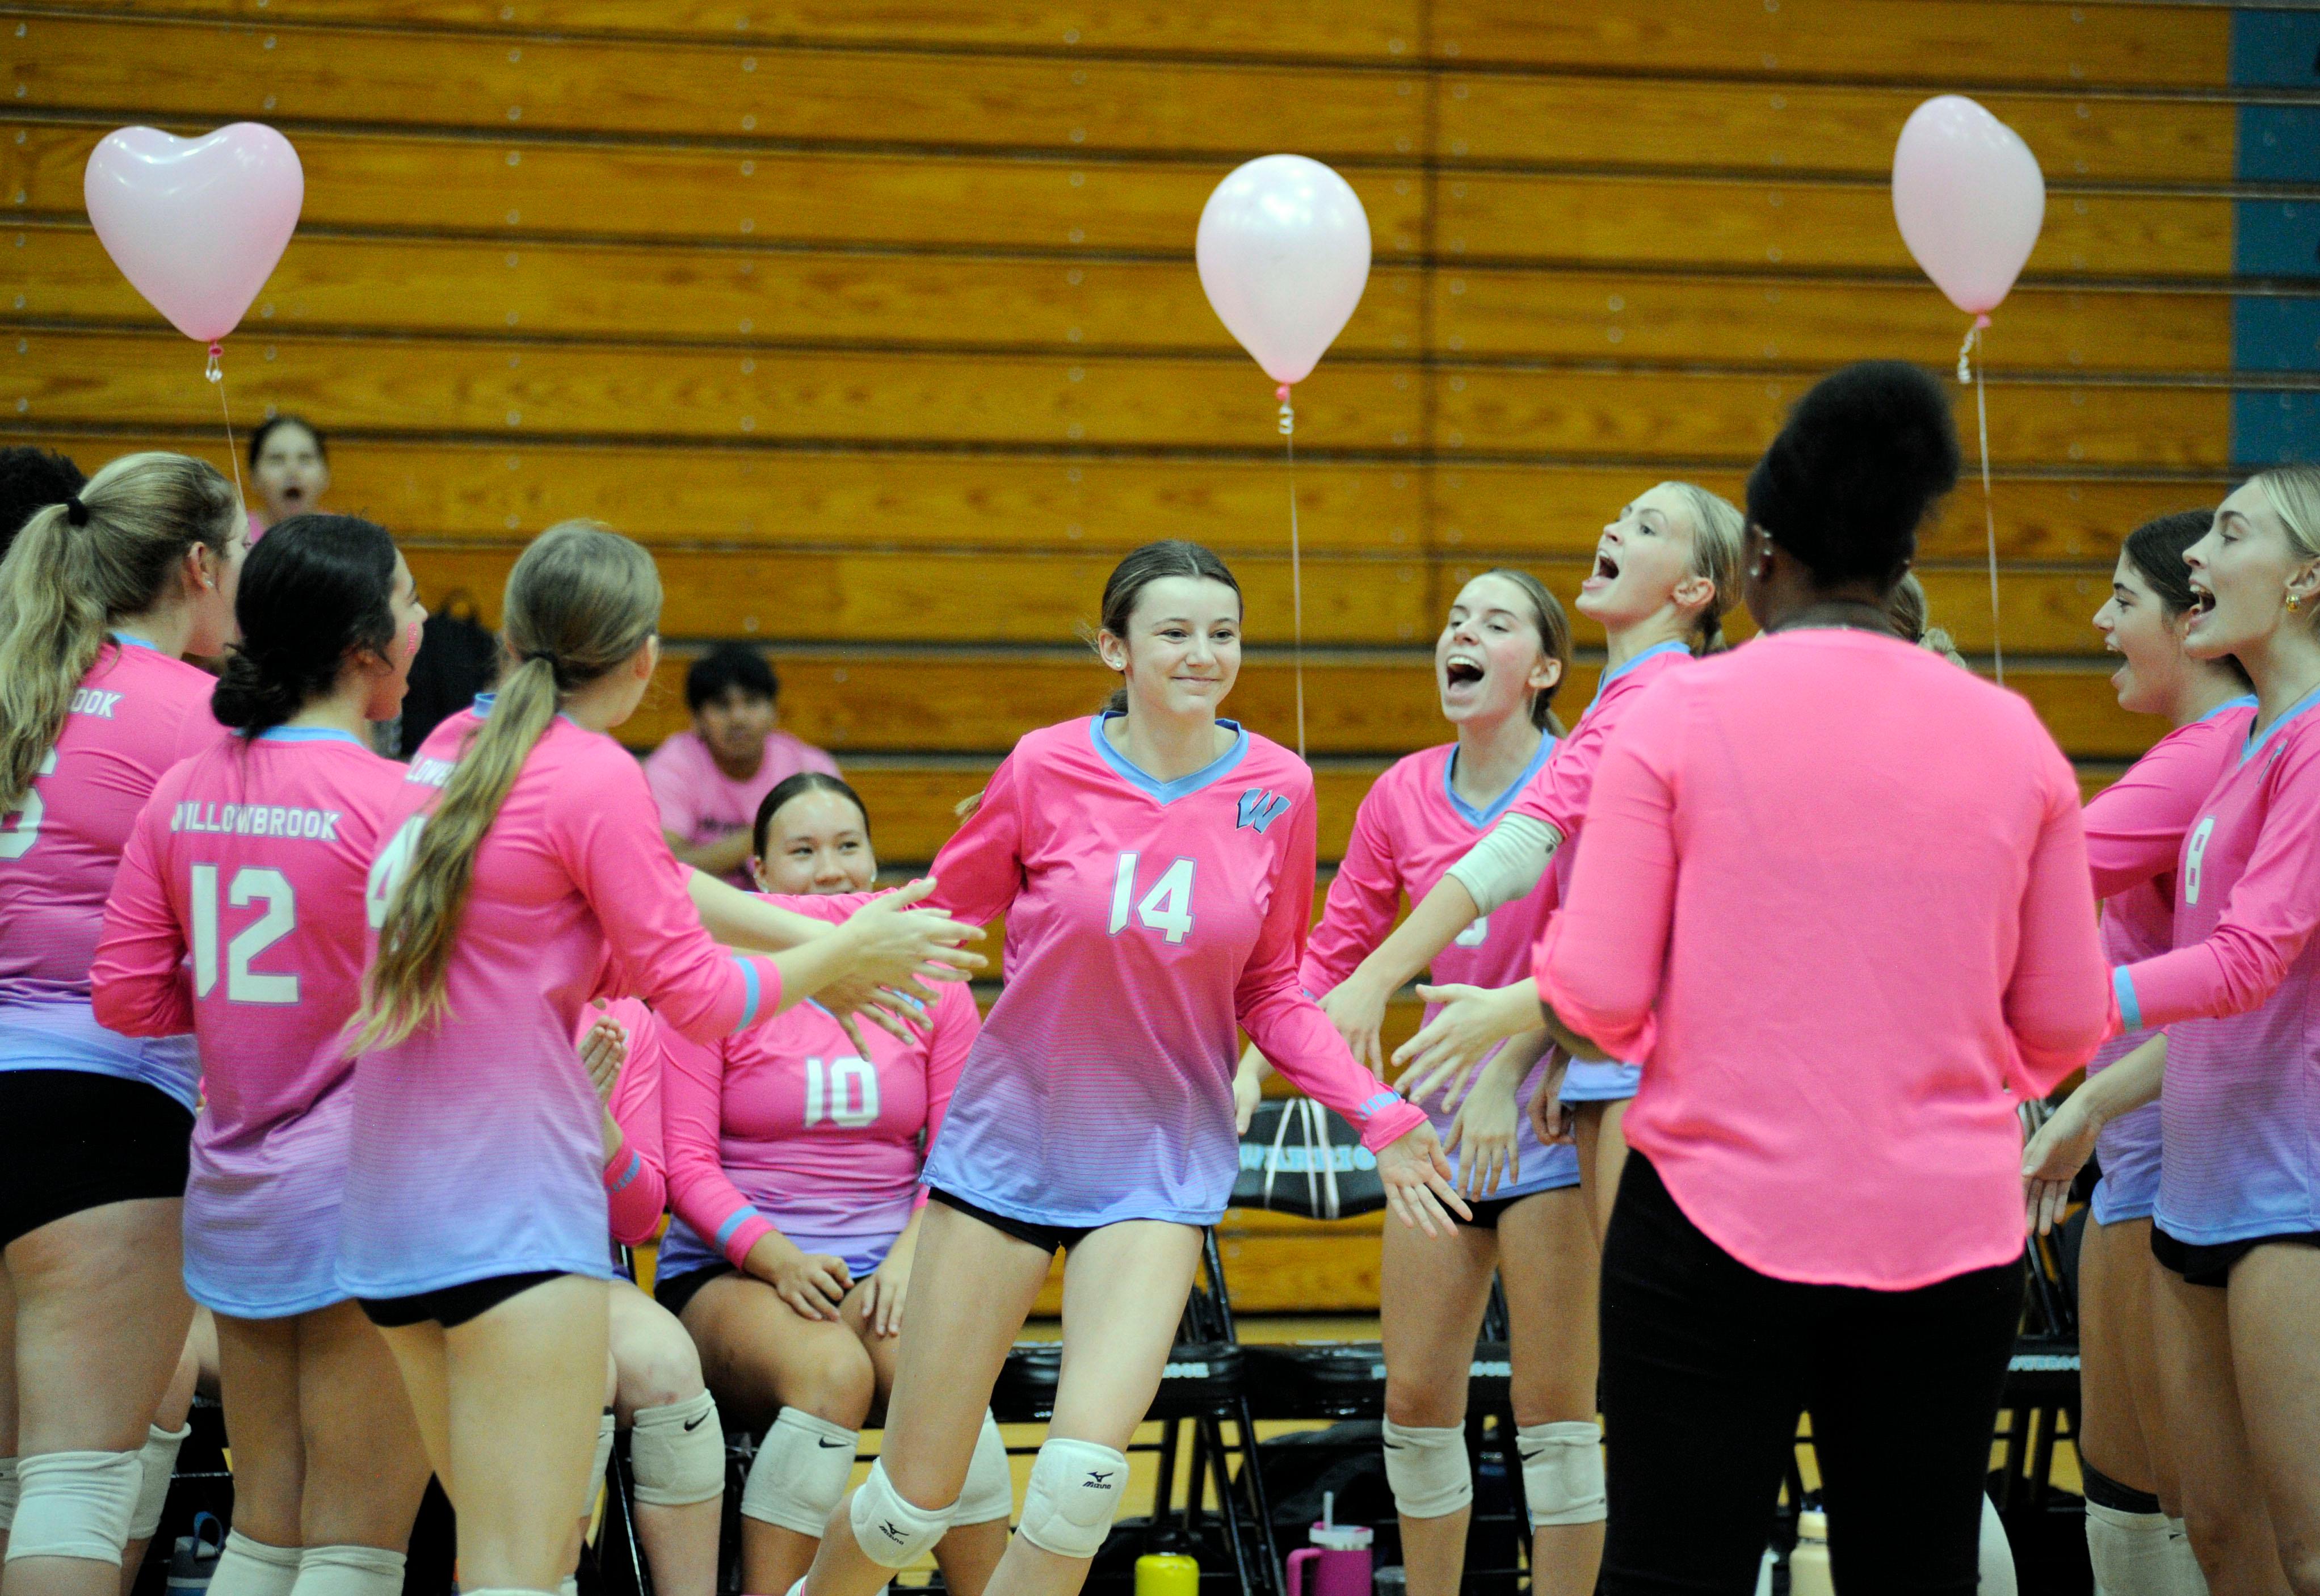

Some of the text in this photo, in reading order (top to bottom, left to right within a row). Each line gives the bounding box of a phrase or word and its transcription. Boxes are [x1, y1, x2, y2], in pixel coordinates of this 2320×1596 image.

[190, 862, 302, 1007] 12
[1106, 850, 1197, 946] 14
[803, 1055, 882, 1129] 10
